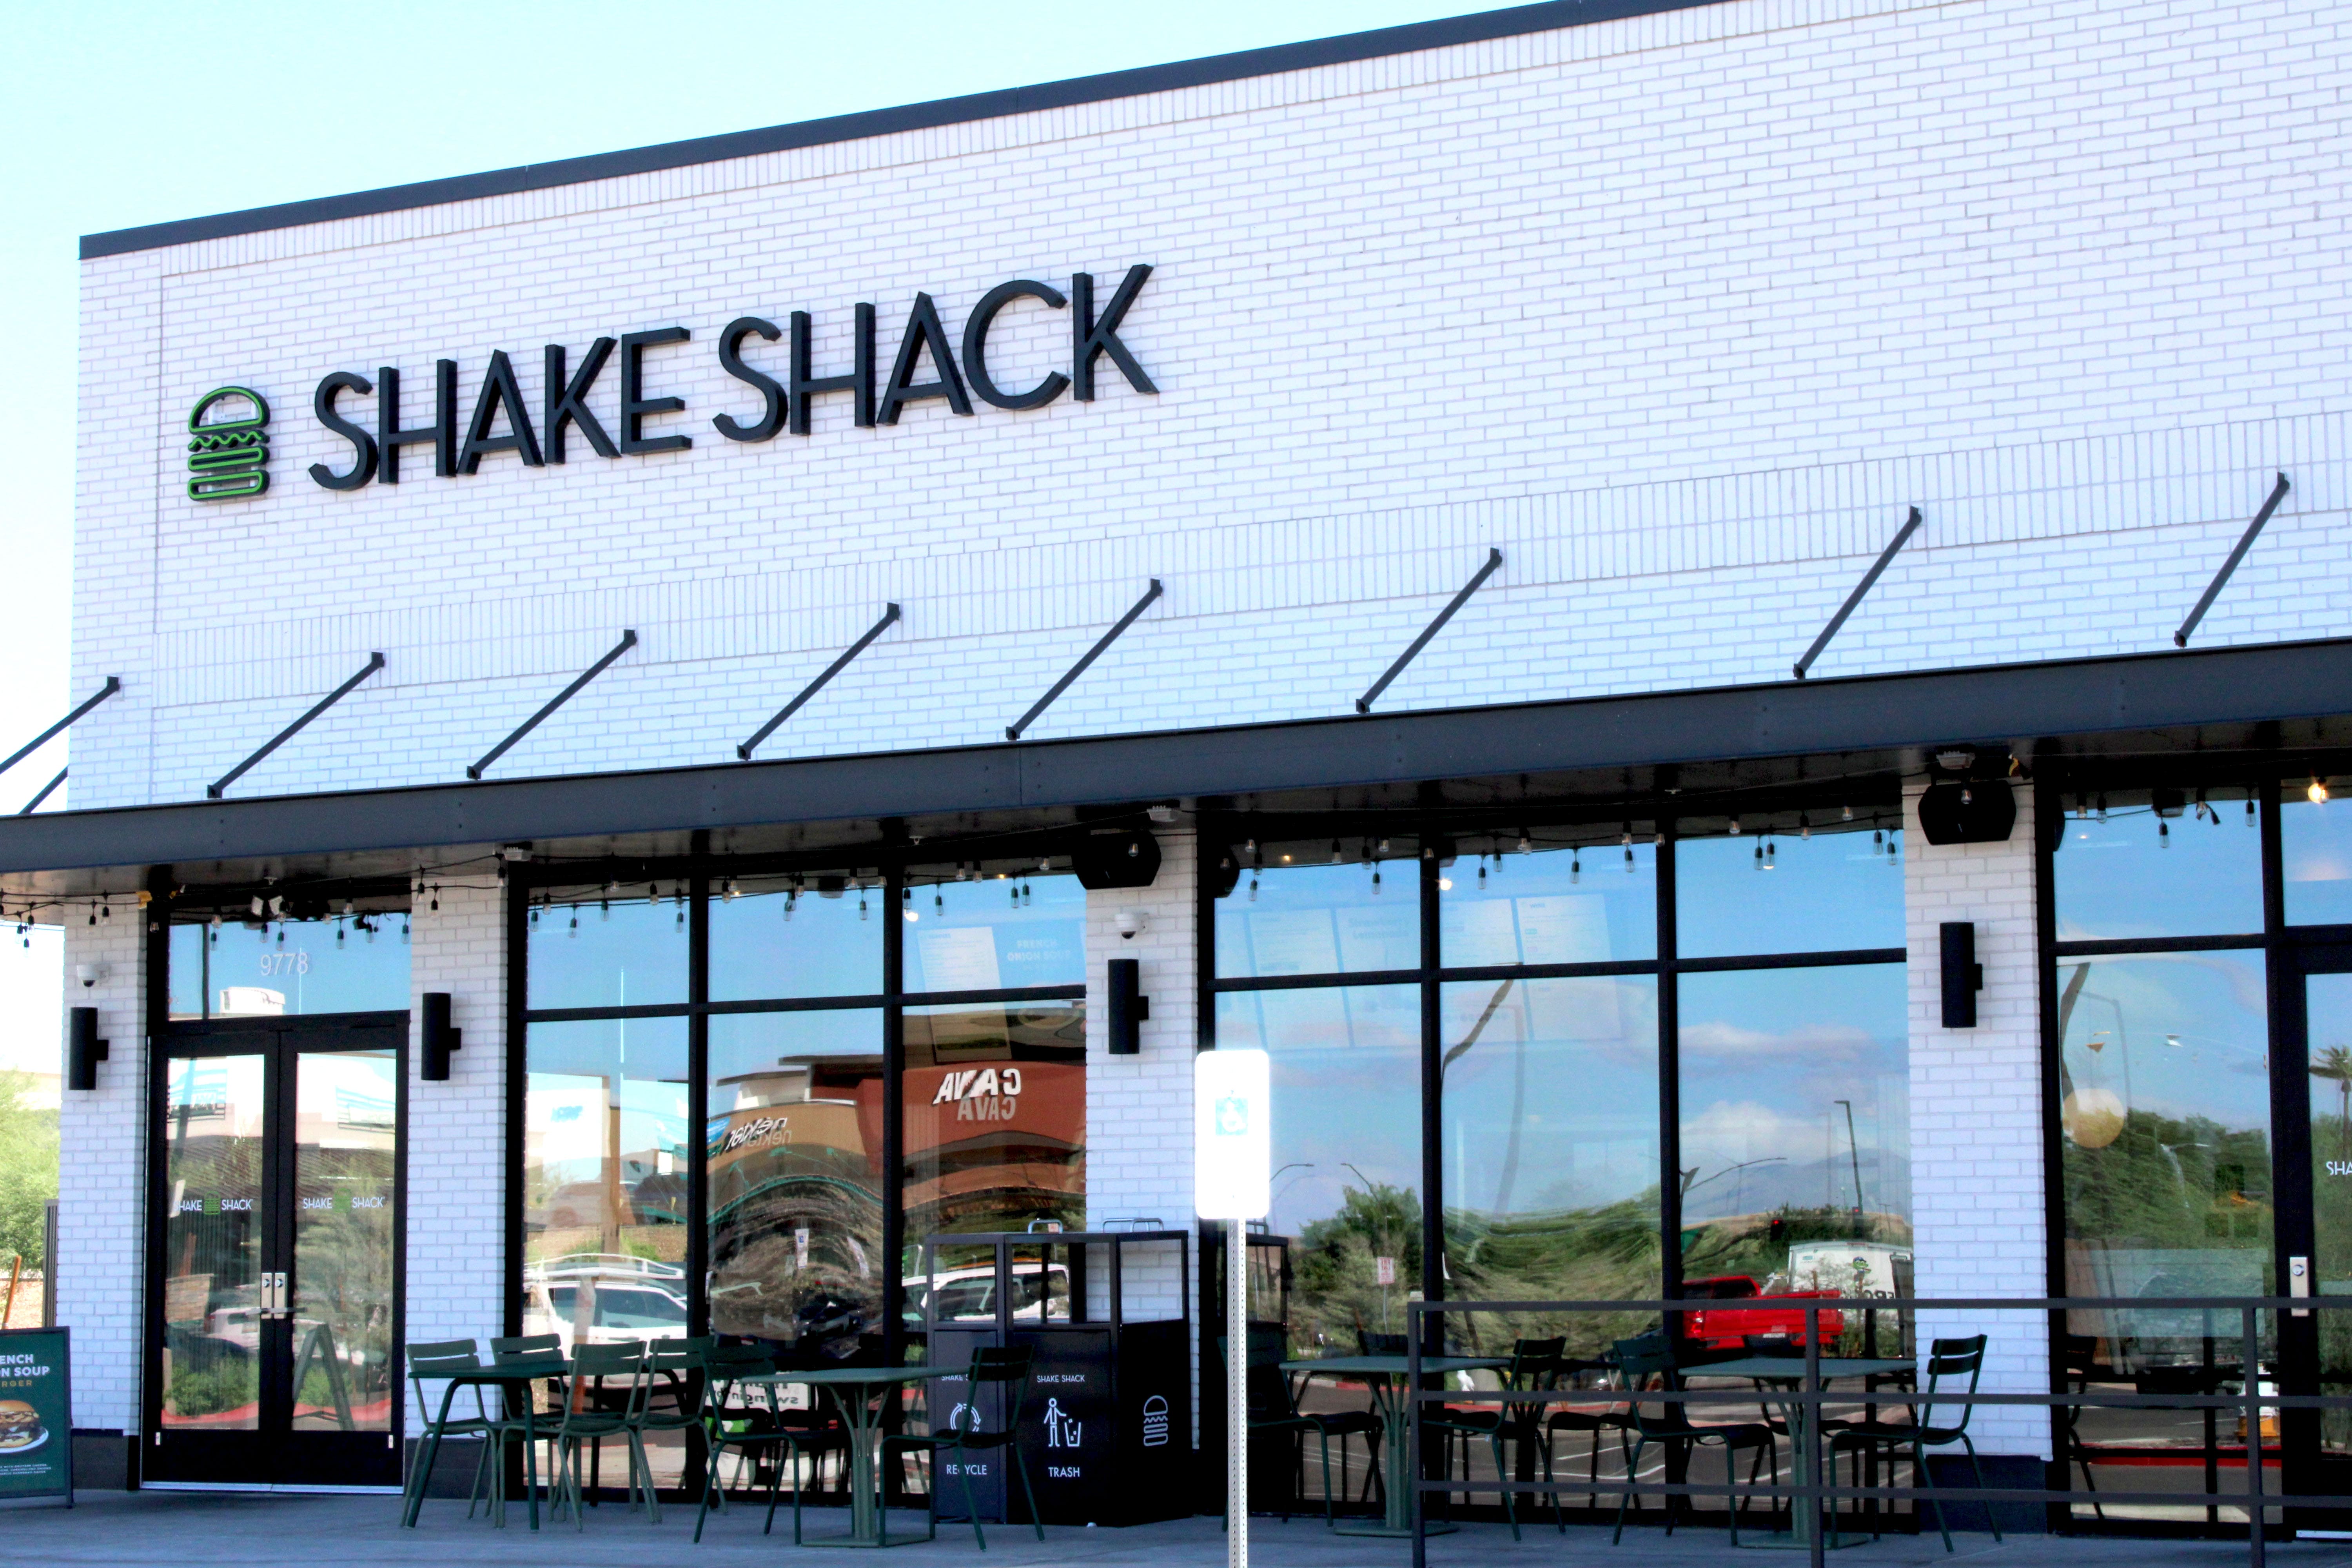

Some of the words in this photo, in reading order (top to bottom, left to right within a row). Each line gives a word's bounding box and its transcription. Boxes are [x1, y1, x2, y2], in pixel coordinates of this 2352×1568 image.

[309, 327, 693, 490] SHAKE
[713, 264, 1160, 443] SHACK
[261, 953, 308, 976] 9778
[2326, 1161, 2352, 1176] SHA
[173, 1199, 202, 1211] SHAKE
[221, 1199, 252, 1210] SHACK
[303, 1198, 332, 1209] SHAKE
[352, 1197, 383, 1209] SHACK
[0, 1354, 33, 1364] ENCH
[14, 1366, 50, 1376] SOUP
[946, 1465, 987, 1475] REYCLE
[1048, 1467, 1080, 1477] TRASH
